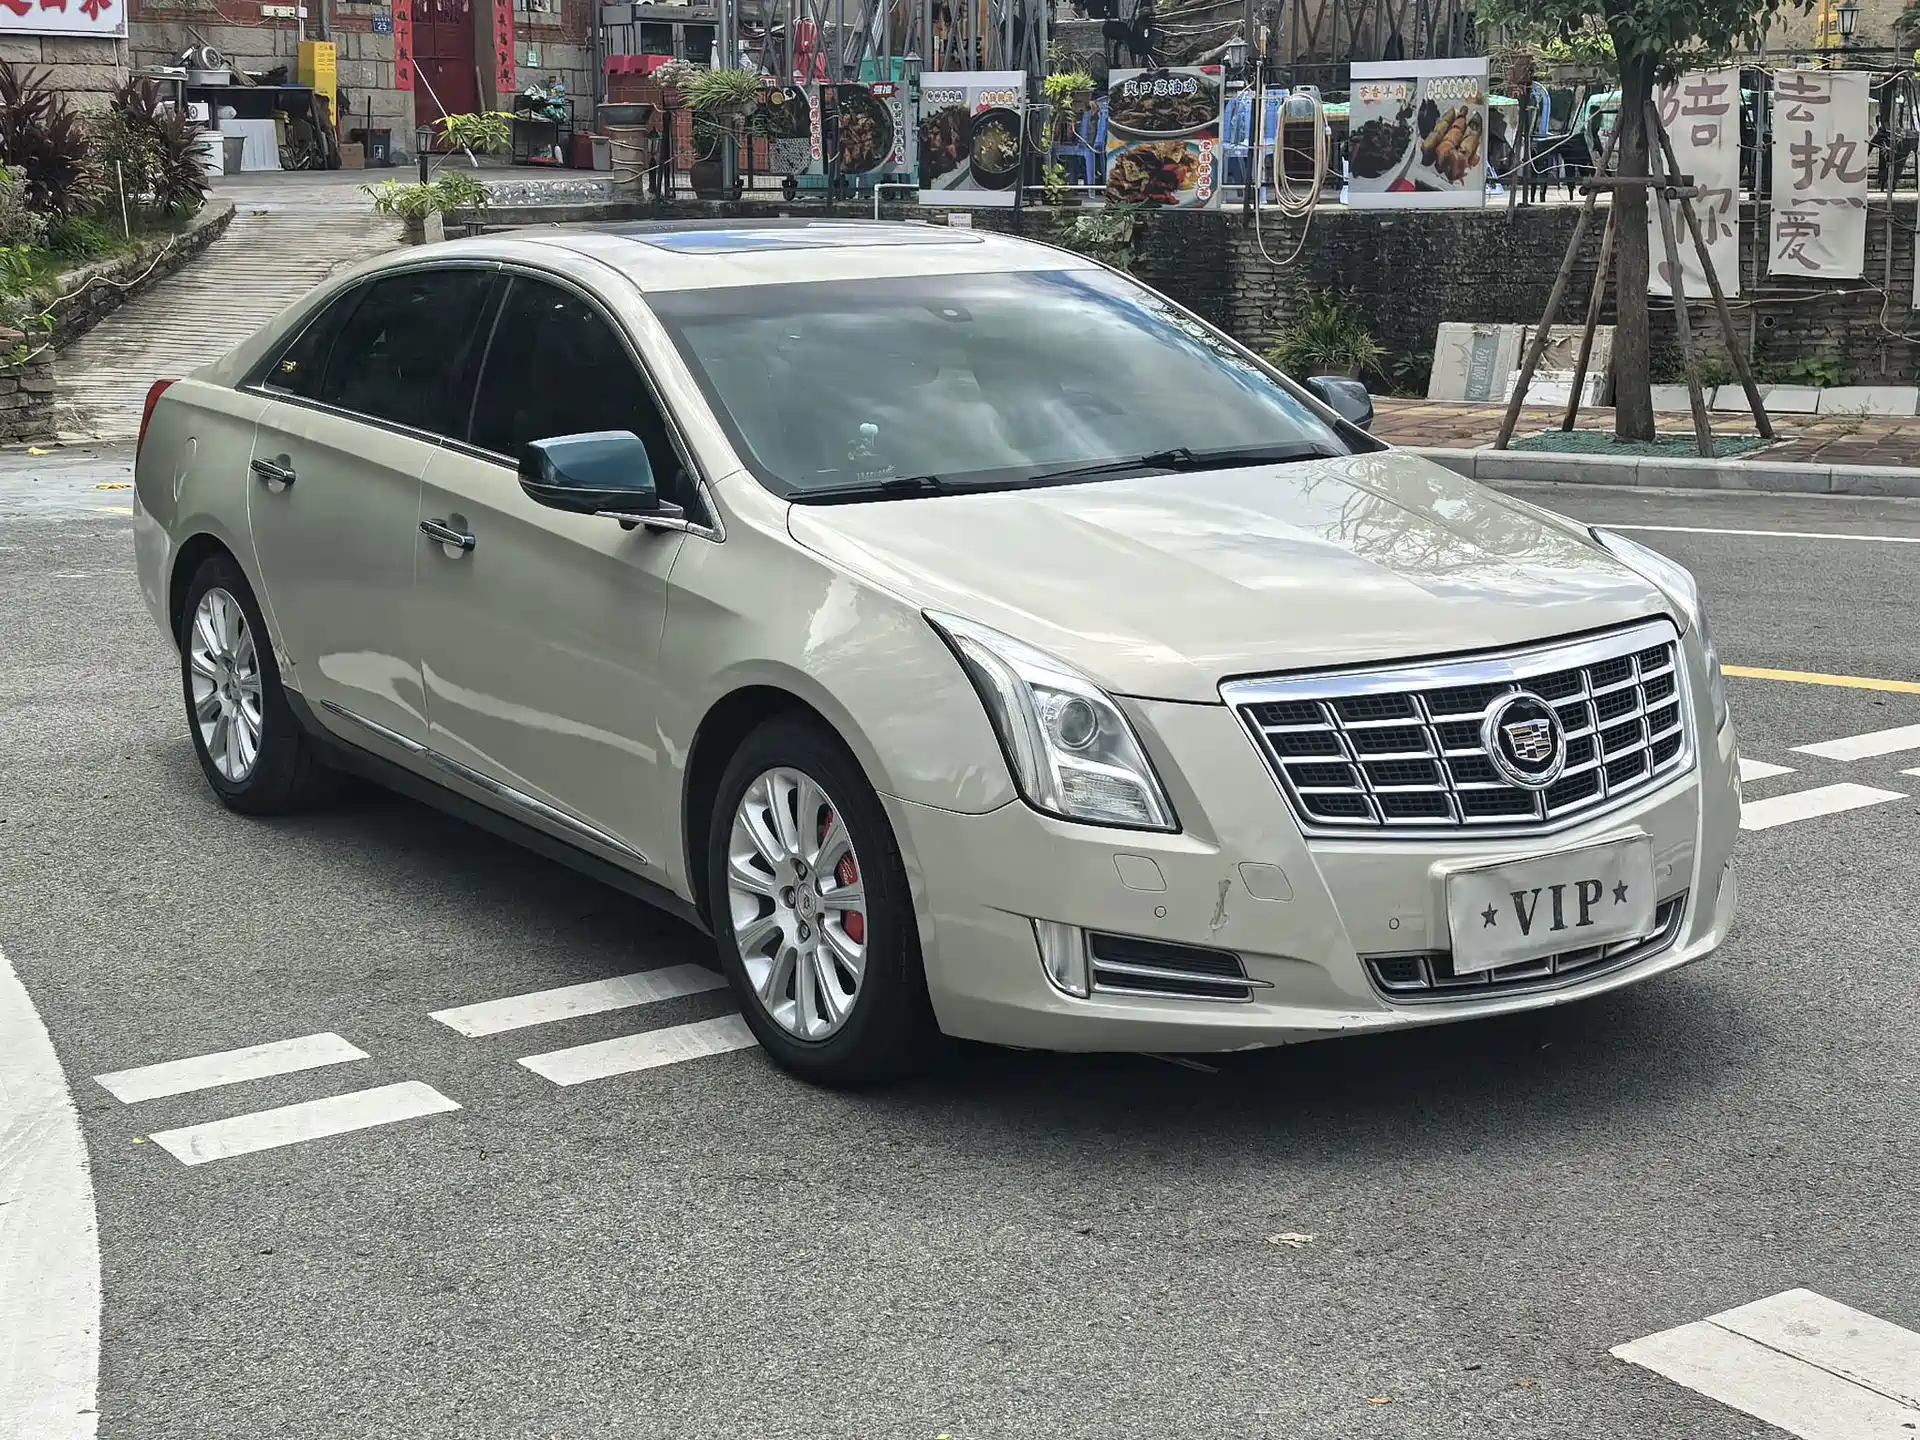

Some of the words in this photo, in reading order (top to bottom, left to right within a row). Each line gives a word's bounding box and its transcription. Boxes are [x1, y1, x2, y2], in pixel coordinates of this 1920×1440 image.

[377, 22, 387, 31] 25
[1124, 78, 1197, 96] 爽口葱油鸡
[1773, 75, 1867, 270] 去热爱
[1510, 879, 1603, 936] VIP
